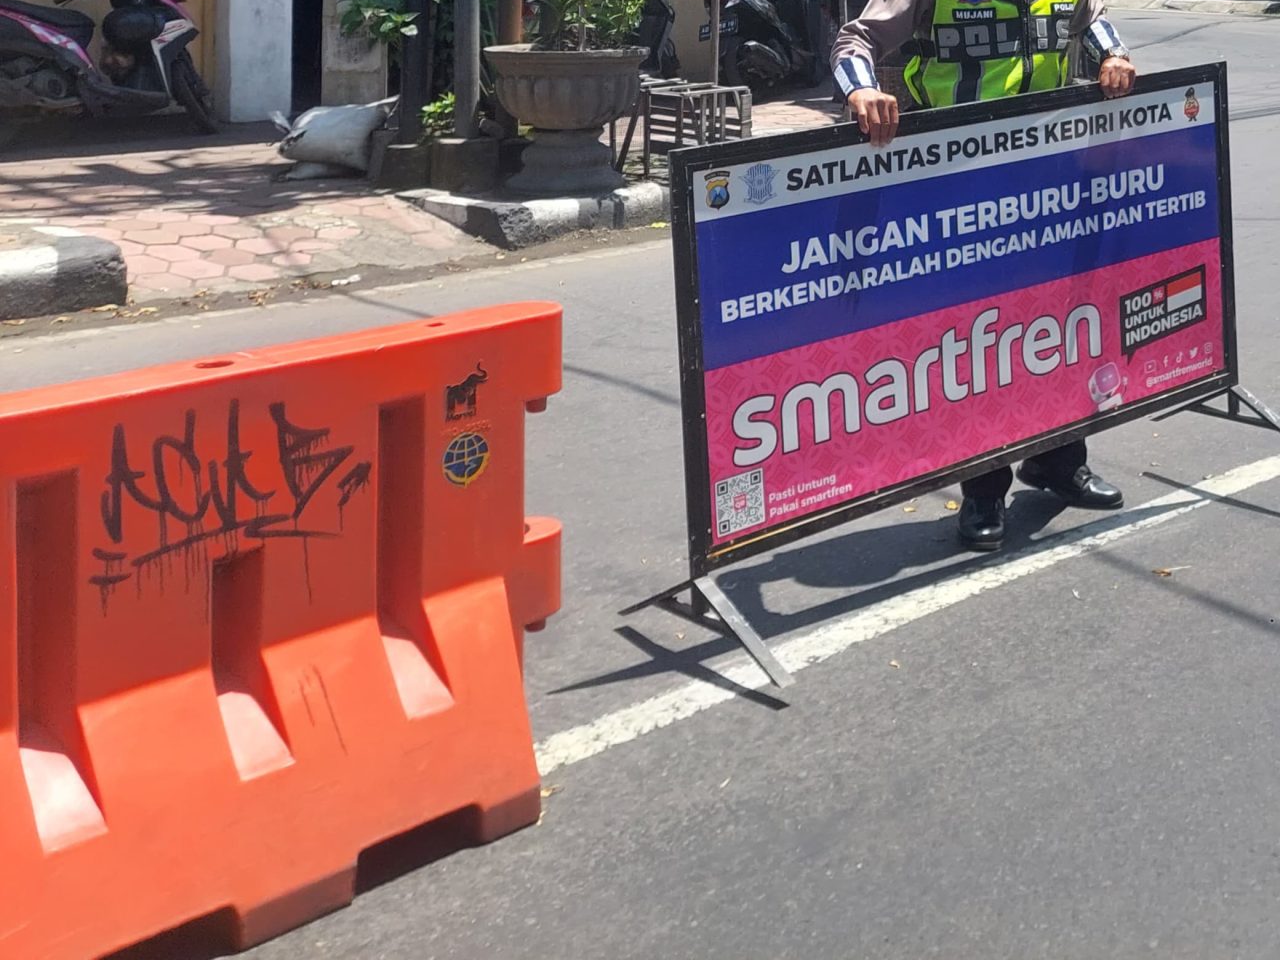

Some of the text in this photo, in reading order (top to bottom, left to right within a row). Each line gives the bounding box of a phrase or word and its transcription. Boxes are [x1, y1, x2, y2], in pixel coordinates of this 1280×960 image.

[956, 10, 993, 19] MUJANI
[786, 102, 1172, 191] SATLANTAS POLRES KEDIRI KOTA
[781, 164, 1164, 274] JANGAN TERBURU-BURU
[720, 190, 1206, 324] BERKENDARALAH DENGAN AMAN DAN TERTIB
[1124, 304, 1165, 329] UNTUK
[1125, 304, 1203, 347] INDONESIA
[731, 302, 1103, 468] smartfren
[1146, 357, 1213, 388] @smartfrenworld
[769, 474, 837, 503] Pasti Untung
[769, 500, 799, 518] Pakai
[801, 483, 853, 507] smartfren
